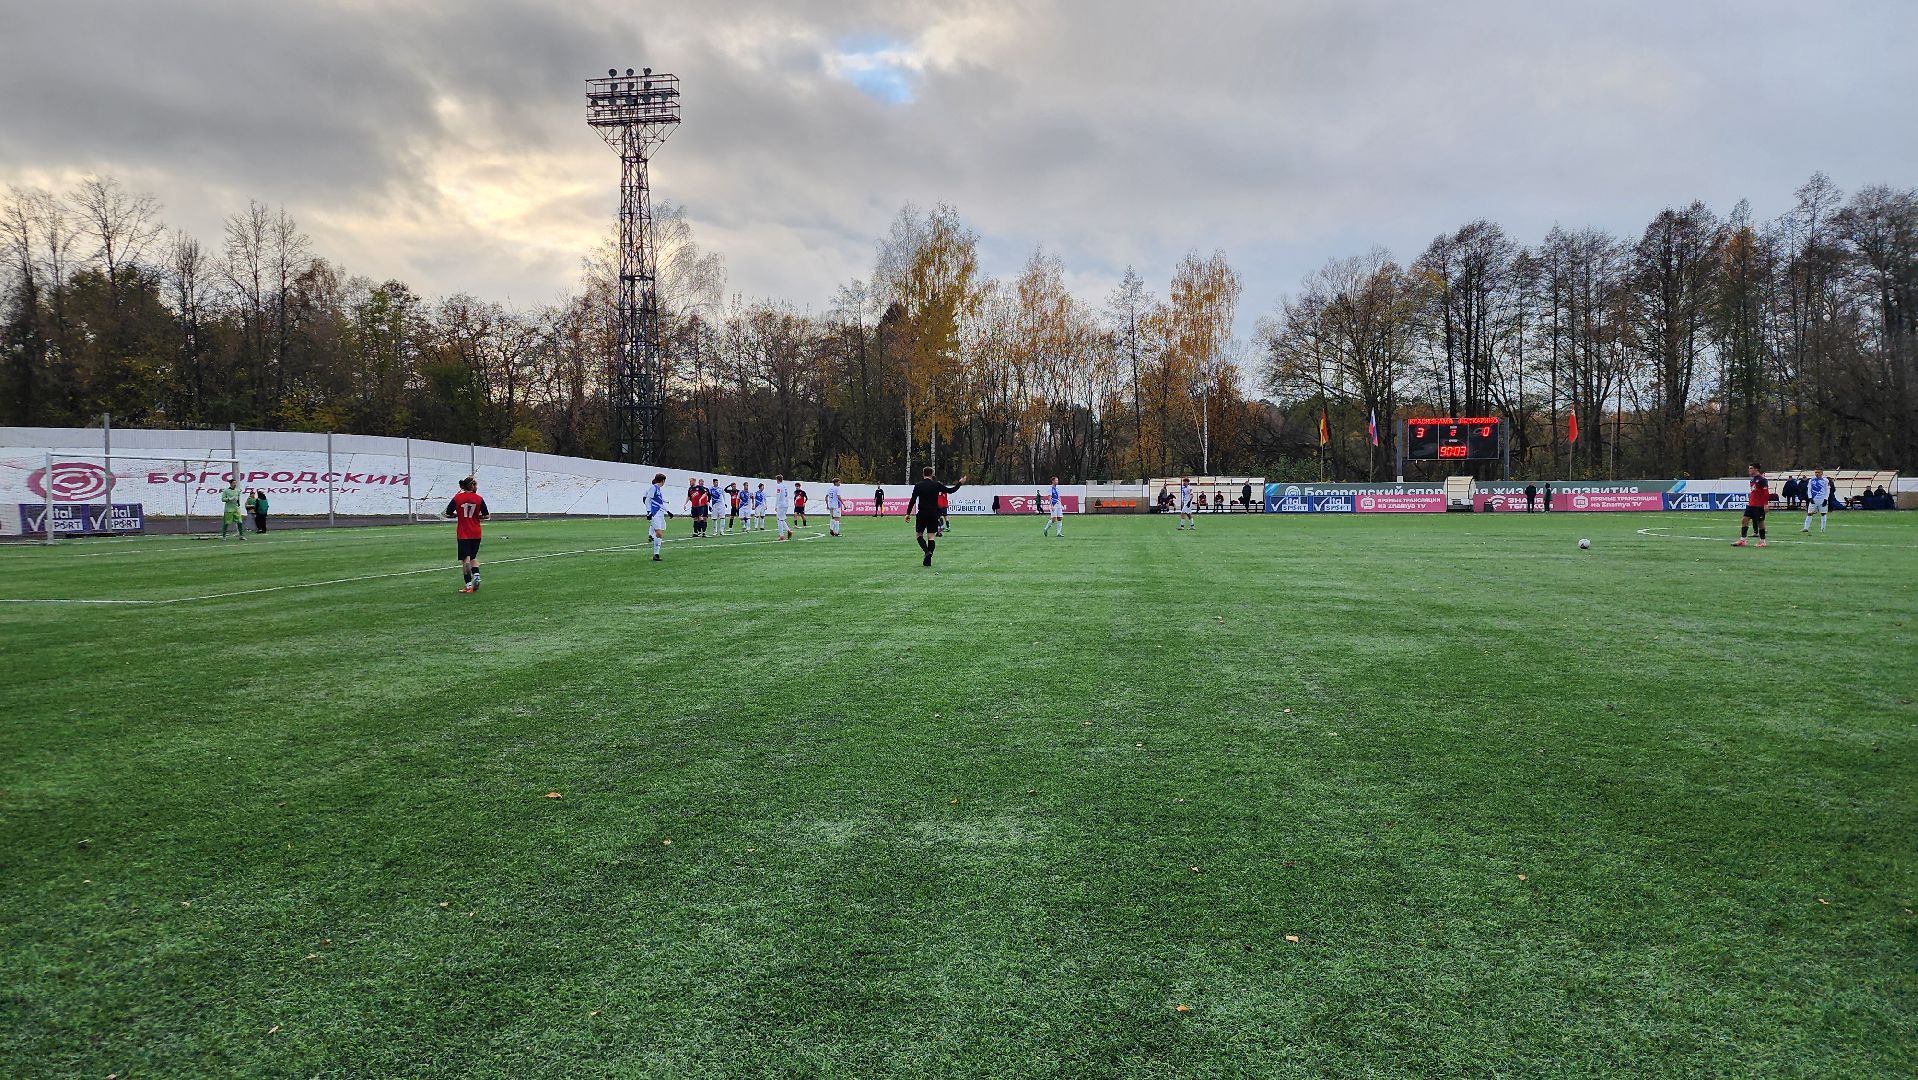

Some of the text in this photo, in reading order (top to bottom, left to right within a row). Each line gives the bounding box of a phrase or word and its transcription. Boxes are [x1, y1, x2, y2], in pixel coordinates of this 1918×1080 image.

[1416, 427, 1425, 438] 3
[1482, 426, 1490, 437] 0
[147, 471, 411, 486] БОГОРОДСКИЙ
[195, 486, 301, 495] ГОРДСКОЙ
[1305, 486, 1404, 496] Богородский
[1407, 488, 1444, 496] спор
[1493, 487, 1544, 495] жизи
[1562, 487, 1639, 495] развития
[461, 503, 476, 518] 17
[54, 518, 81, 530] PORT
